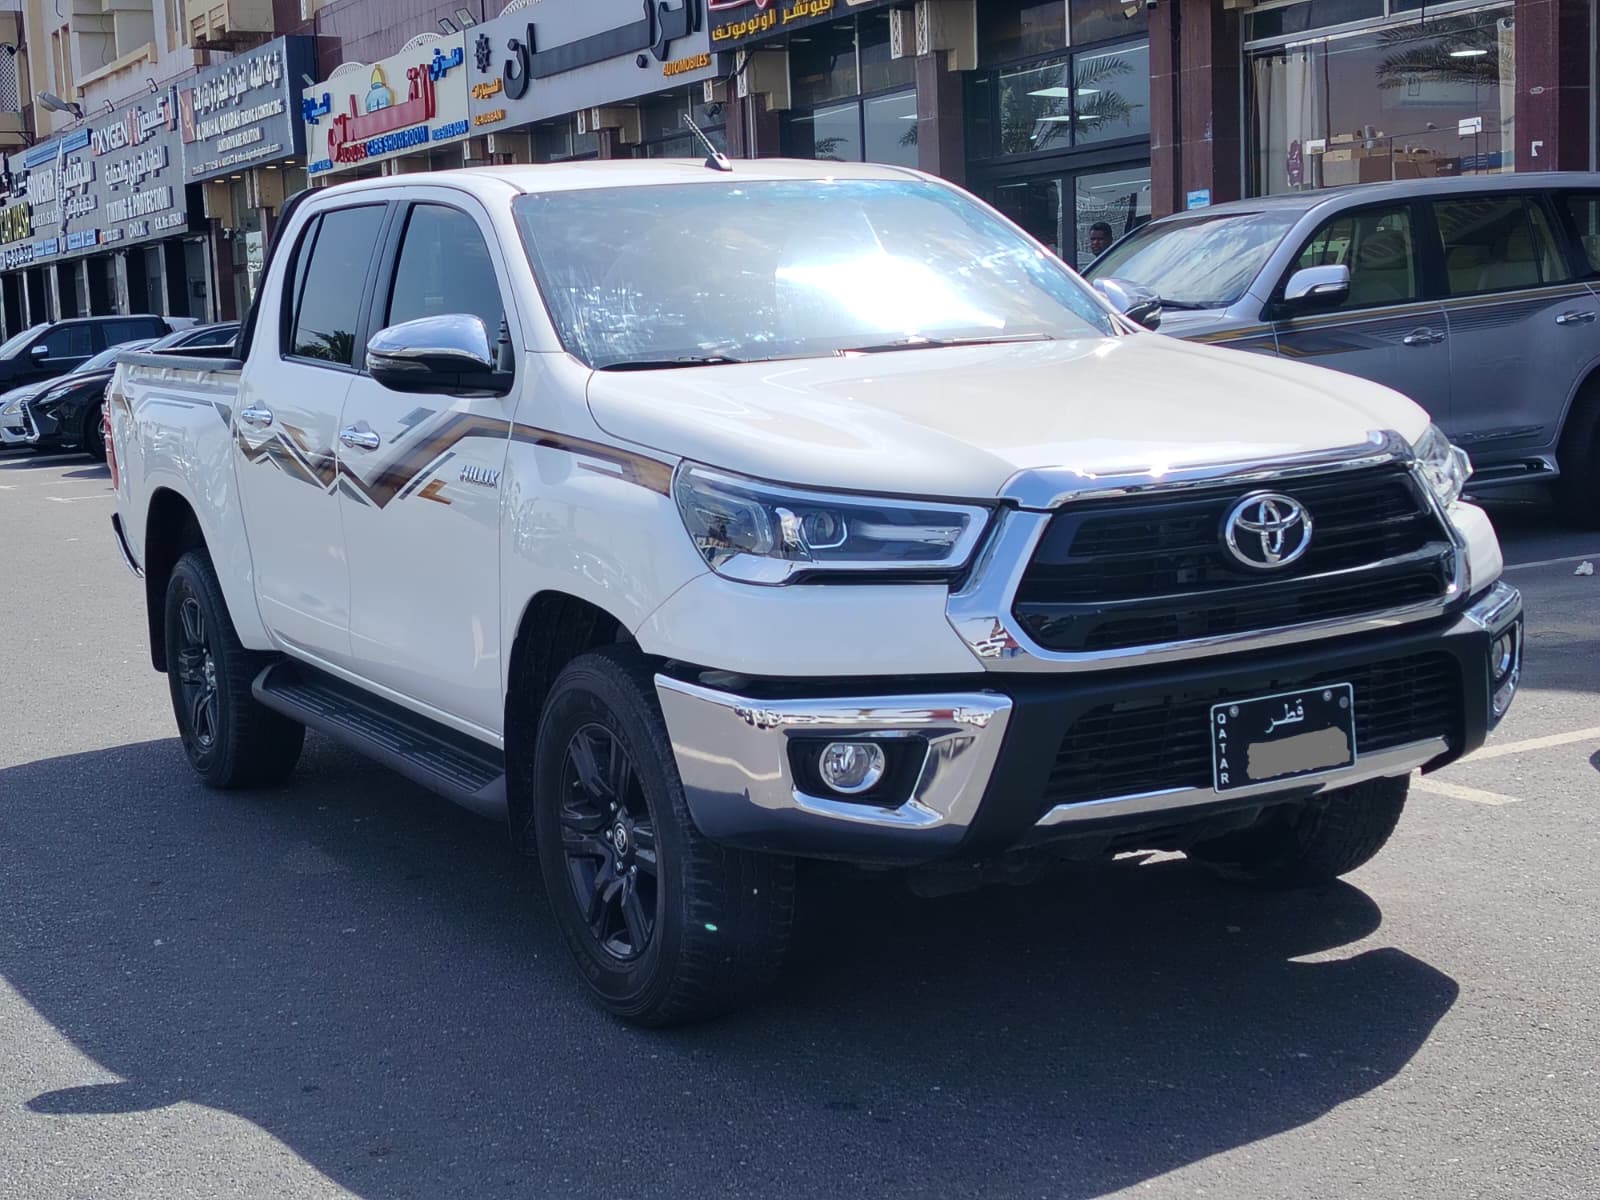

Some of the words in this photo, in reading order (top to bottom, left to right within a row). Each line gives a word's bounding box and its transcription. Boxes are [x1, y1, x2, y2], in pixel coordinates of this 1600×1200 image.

[663, 53, 711, 77] AUTOMOBILES
[91, 119, 129, 157] OXYGEN
[367, 137, 386, 157] CARS
[383, 125, 429, 152] SHOWROOM
[133, 186, 170, 219] PROTECTION
[460, 464, 501, 488] HILUX
[1264, 698, 1305, 734] قطر
[1216, 713, 1230, 785] QATAR
